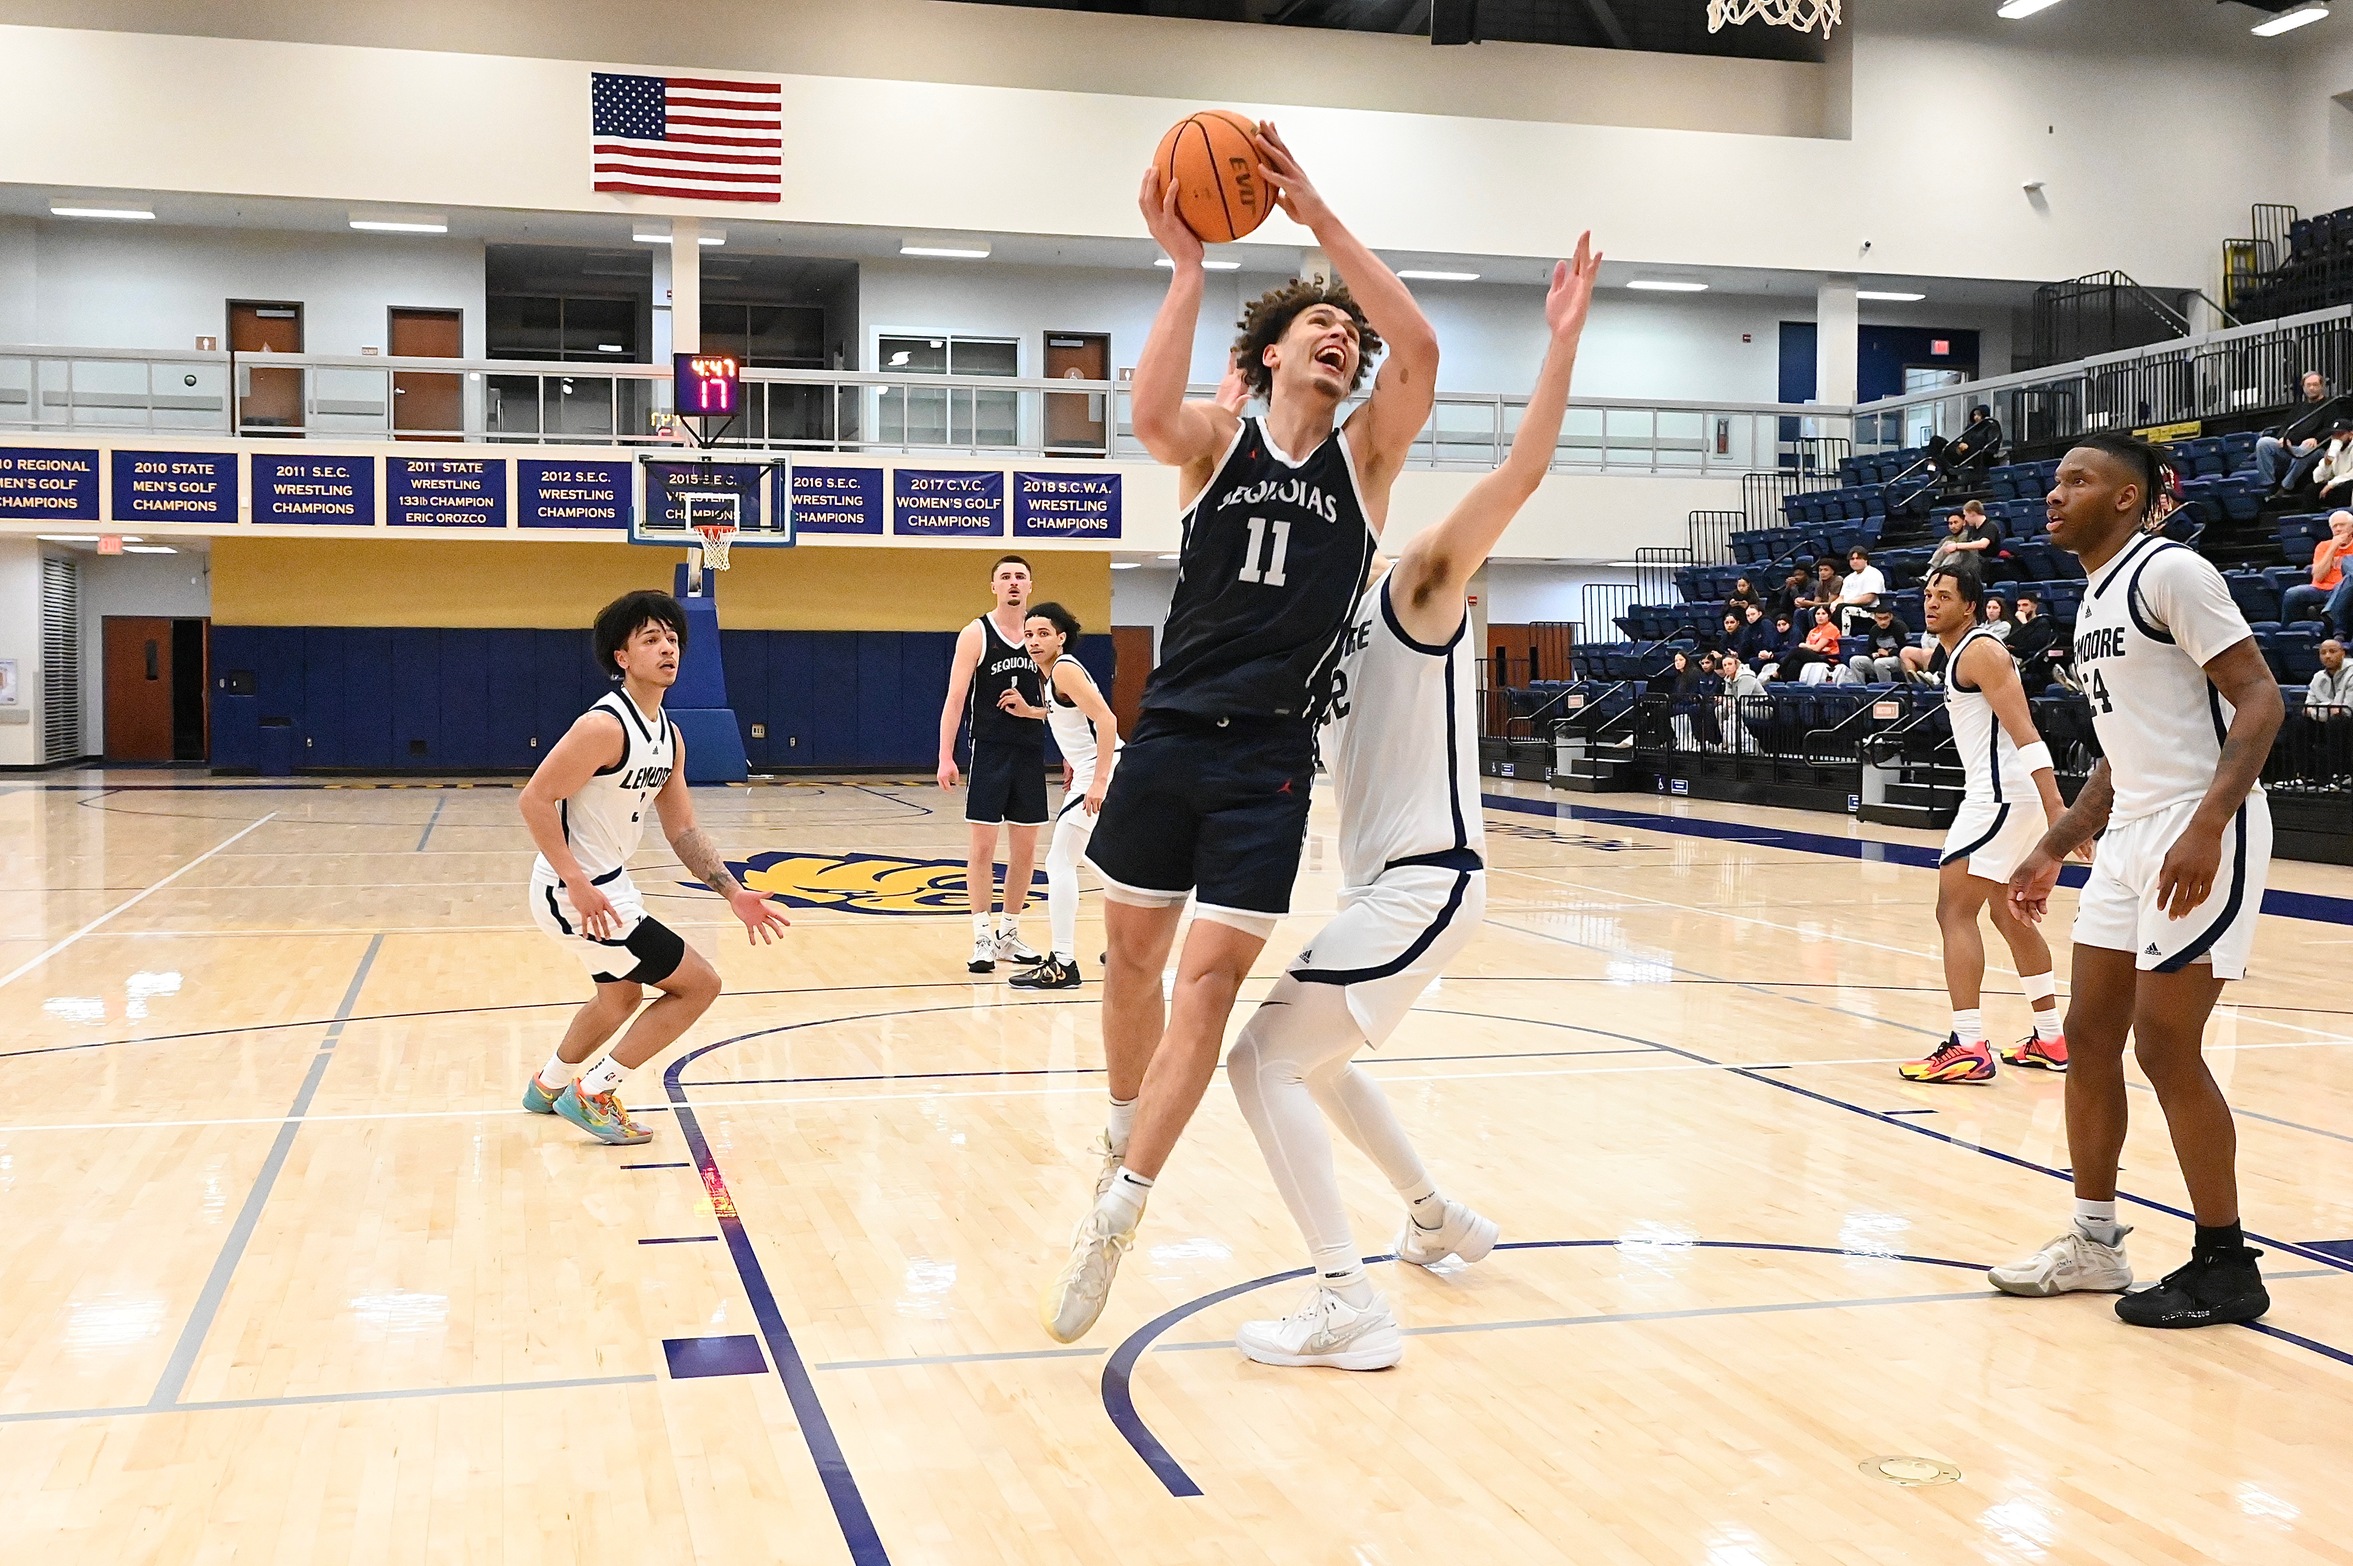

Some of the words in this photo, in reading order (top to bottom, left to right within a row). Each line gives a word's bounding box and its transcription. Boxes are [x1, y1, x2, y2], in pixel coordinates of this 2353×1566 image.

[692, 359, 735, 377] 4:47
[702, 379, 727, 409] 17
[18, 459, 90, 471] REGIONAL
[135, 462, 167, 473] 2010
[172, 463, 214, 474] STATE
[408, 462, 435, 472] 2011
[442, 463, 483, 473] STATE
[277, 466, 304, 476] 2011
[313, 467, 349, 477] S.E.C.
[541, 471, 571, 481] 2012
[576, 472, 611, 482] S.E.C.
[39, 479, 78, 489] GOLF
[411, 479, 480, 489] WRESTLING
[669, 473, 698, 484] 2015
[794, 477, 822, 487] 2016
[827, 478, 860, 488] S.E.C.
[134, 481, 177, 492] MEN'S
[179, 482, 217, 493] GOLF
[274, 484, 352, 496] WRESTLING
[911, 479, 943, 490] 2017
[947, 480, 984, 491] C.V.C.
[1023, 481, 1055, 492] 2018
[1059, 482, 1111, 493] S.C.W.A.
[539, 489, 613, 500] WRESTLING
[0, 497, 77, 508] HAMPIONS
[133, 500, 217, 511] CHAMPIONS
[399, 496, 428, 505] 133lb
[430, 497, 493, 506] CHAMPION
[793, 495, 863, 506] WRESTLING
[896, 497, 962, 508] WOMEN'S
[965, 498, 1001, 509] GOLF
[1028, 499, 1107, 511] WRESTLING
[273, 503, 354, 514] CHAMPIONS
[538, 507, 615, 518] CHAMPIONS
[665, 508, 740, 520] CHMPION
[406, 513, 433, 522] ERIC
[436, 514, 486, 523] OROZCO
[908, 515, 990, 527] CHAMPIONS
[1027, 518, 1107, 529] CHAMPIONS
[1238, 517, 1291, 587] 11
[2075, 627, 2126, 667] MOORE
[1322, 669, 1350, 726] 2
